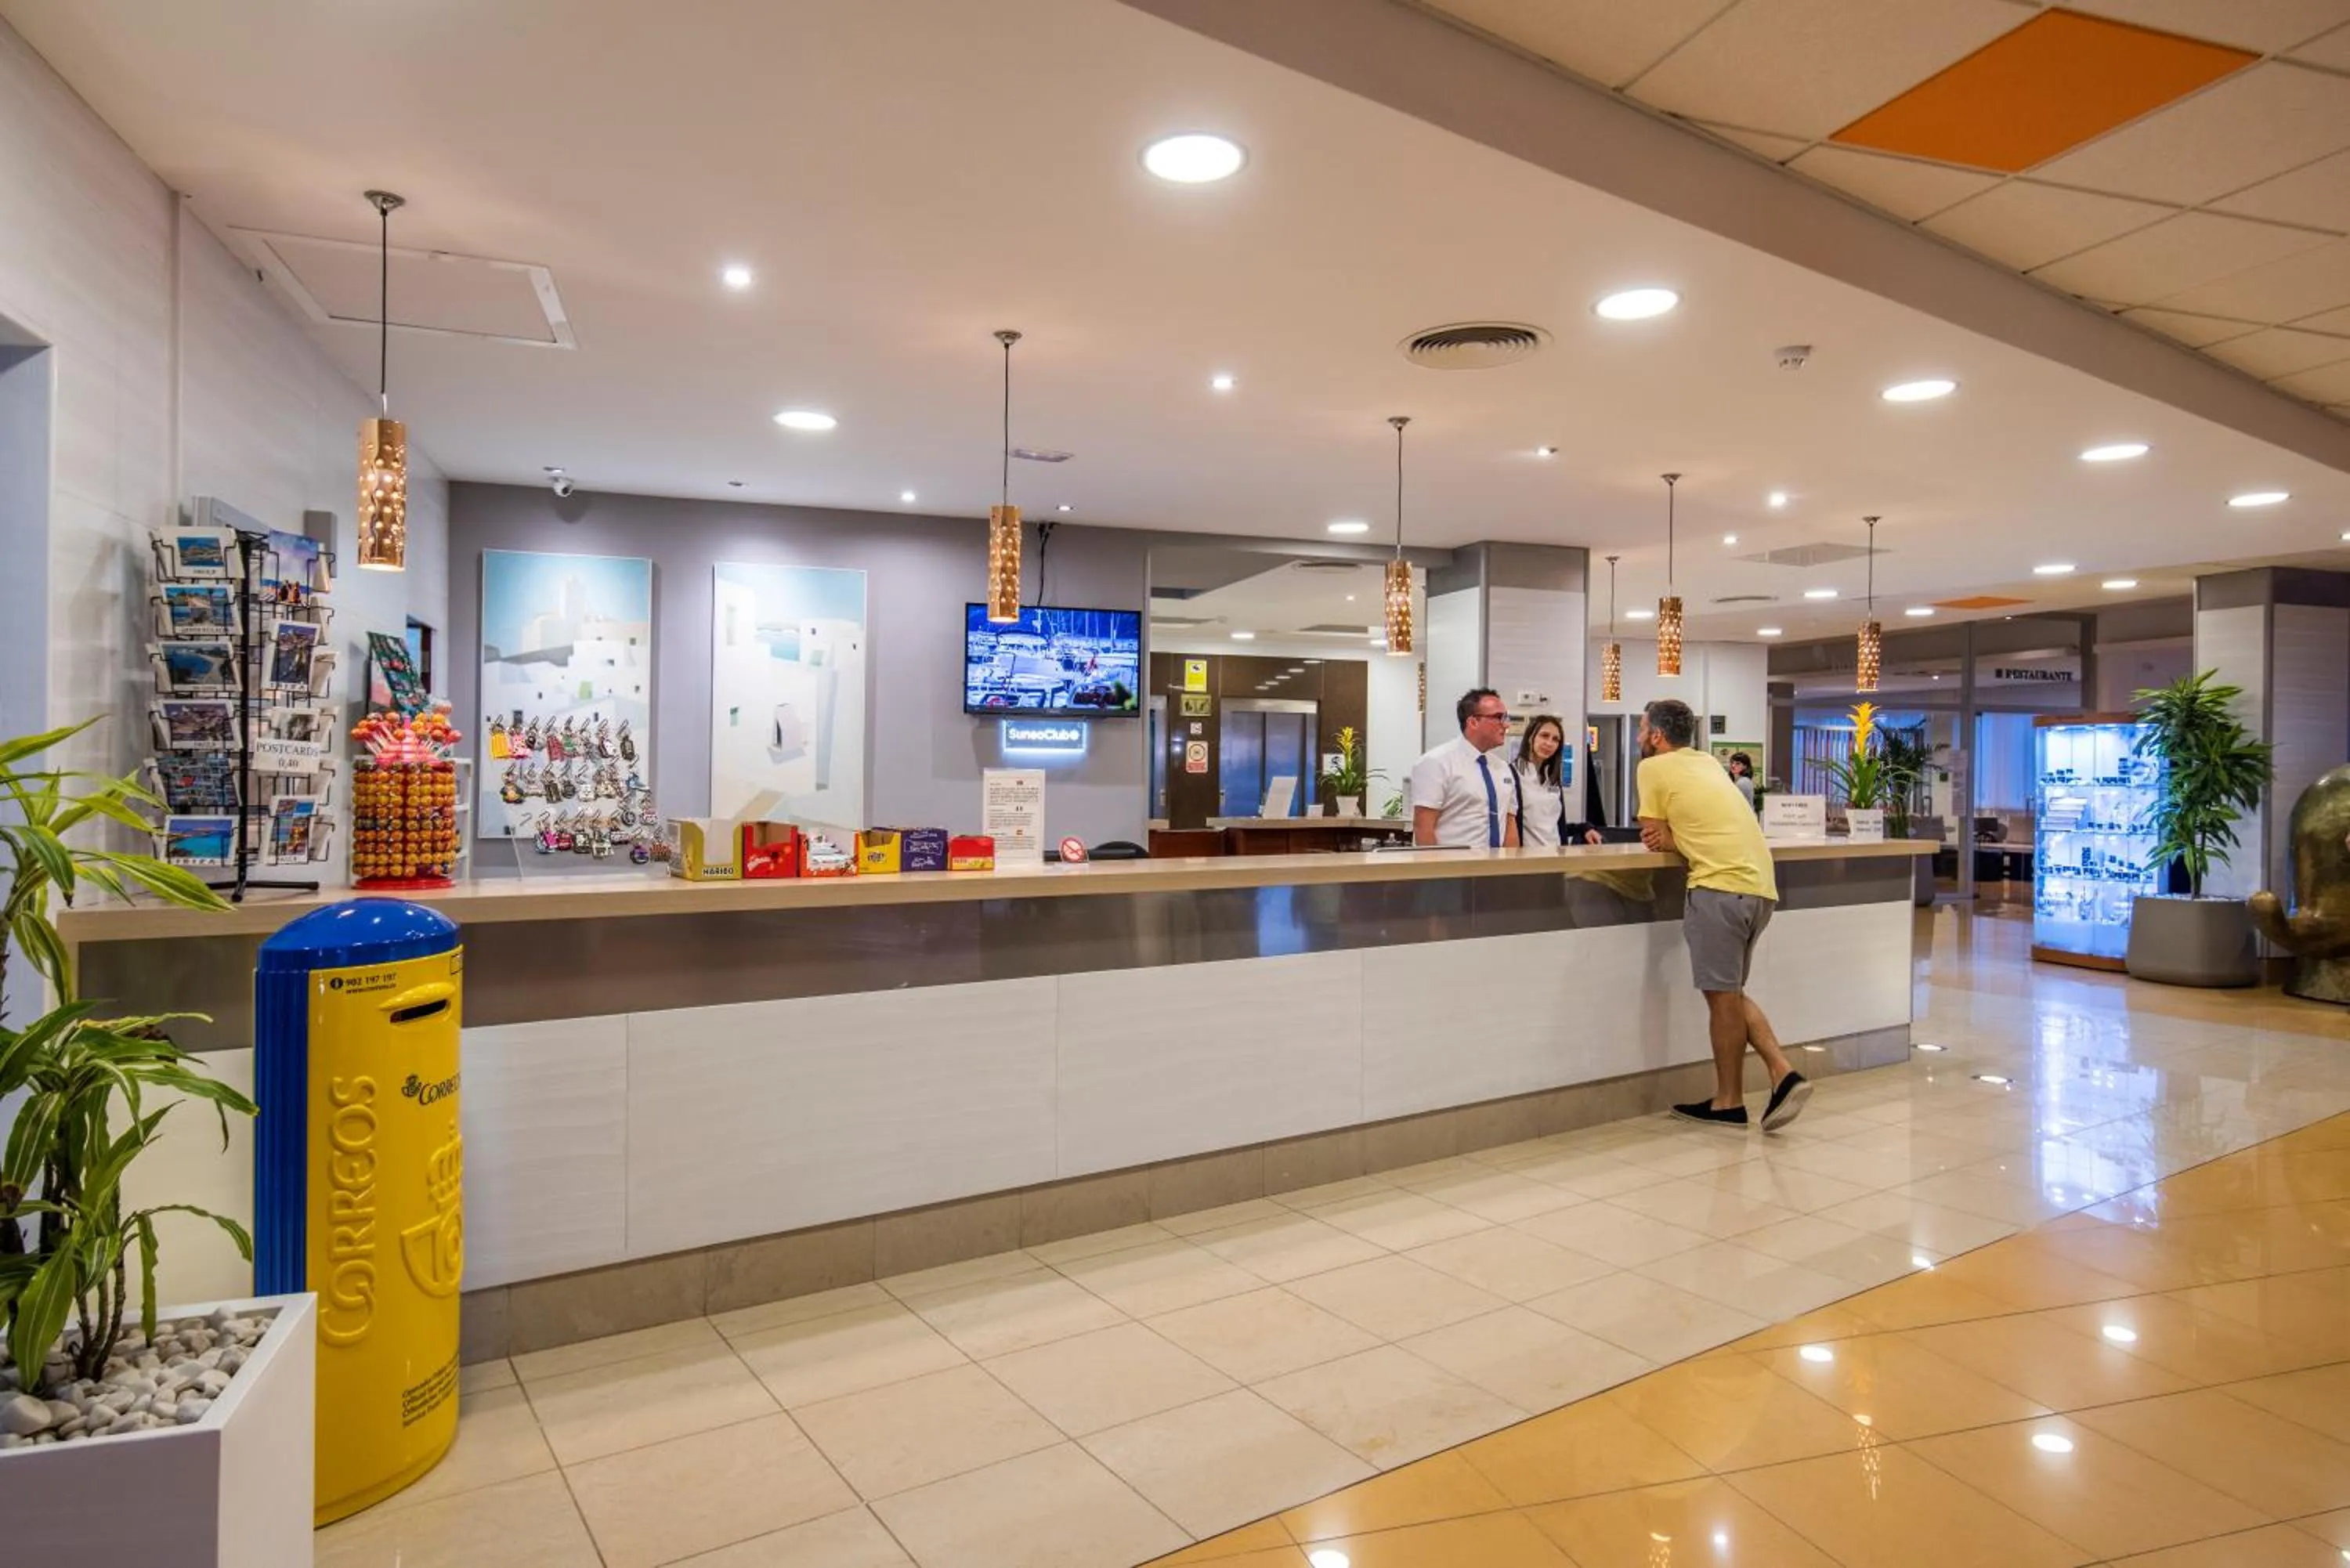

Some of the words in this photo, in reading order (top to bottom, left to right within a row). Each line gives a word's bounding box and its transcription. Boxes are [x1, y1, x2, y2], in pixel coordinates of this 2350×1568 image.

[2005, 668, 2073, 681] RESTAURANTE
[256, 742, 319, 758] POSTCARDS
[703, 866, 735, 876] HARIBO
[366, 975, 380, 985] 197
[319, 1075, 378, 1349] CORREOS
